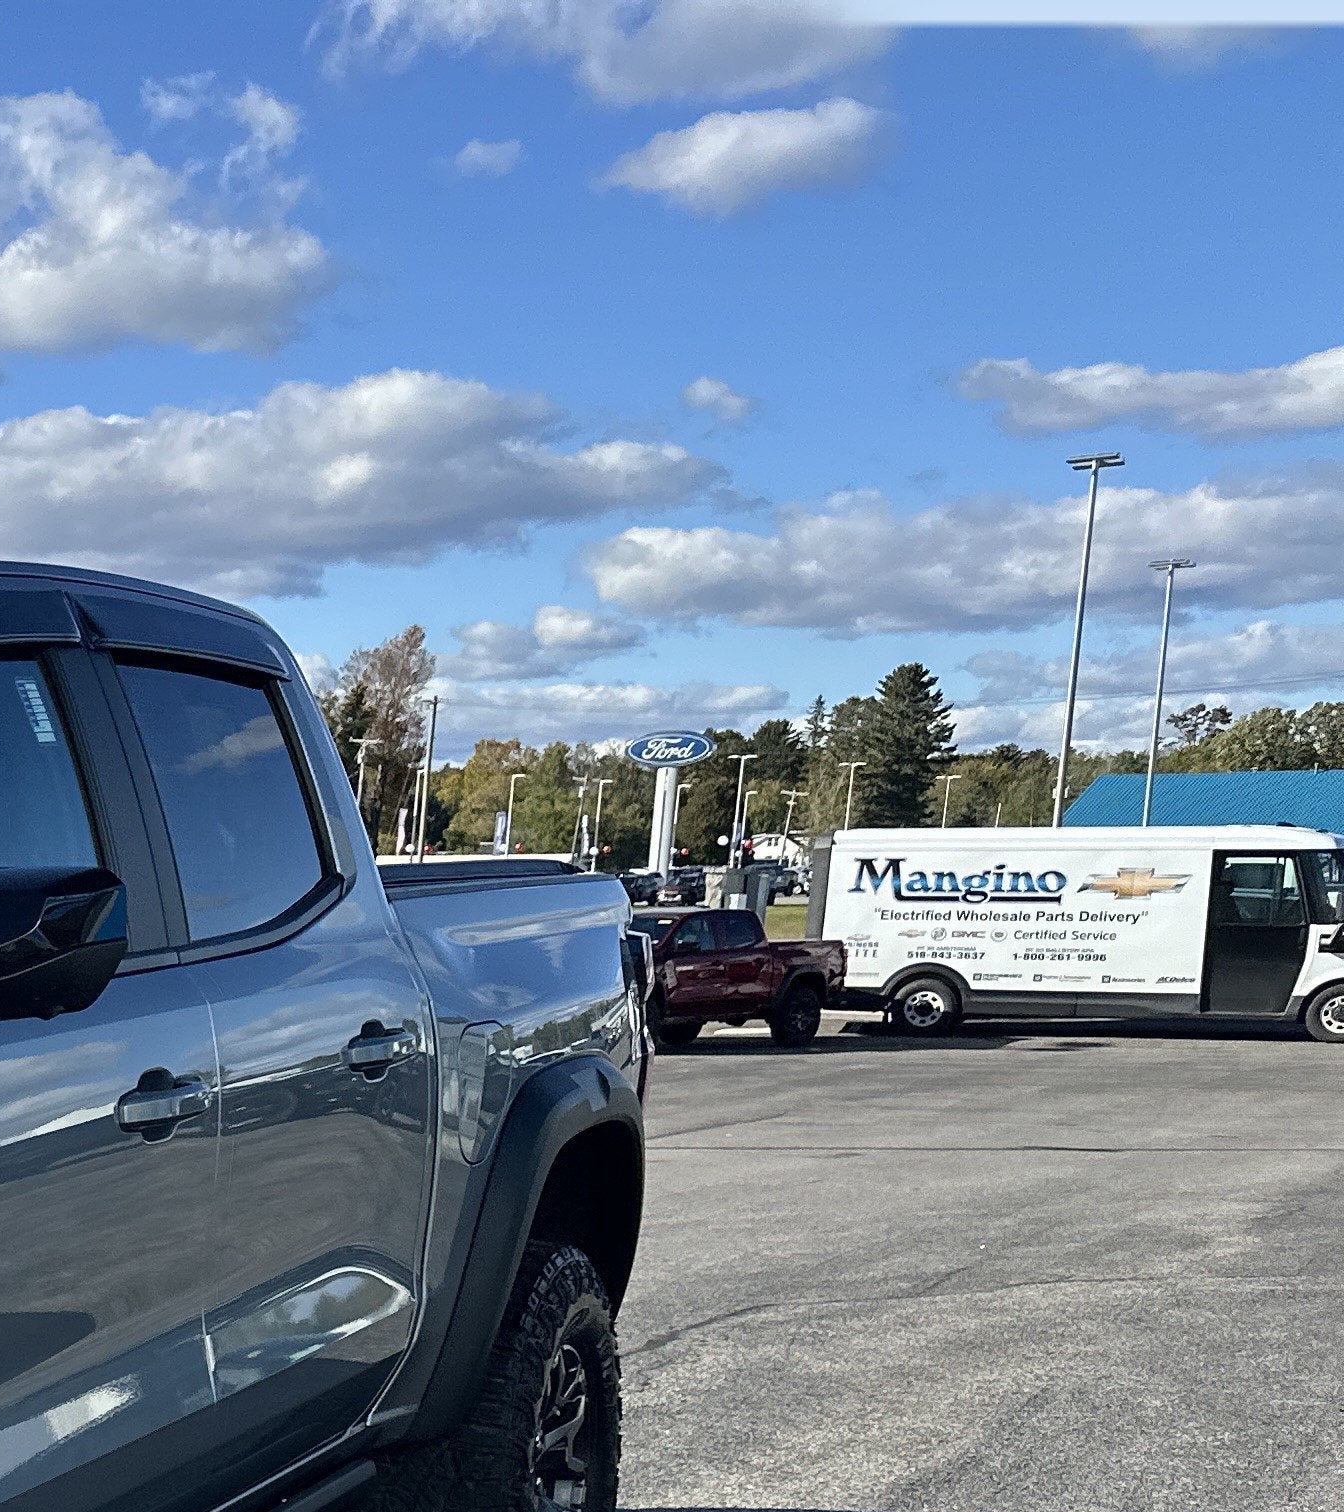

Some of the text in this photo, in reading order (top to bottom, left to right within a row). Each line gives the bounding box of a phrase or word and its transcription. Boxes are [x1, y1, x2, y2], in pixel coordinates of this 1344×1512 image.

[642, 737, 696, 760] Ford
[847, 857, 1068, 904] Mangino
[956, 910, 1031, 923] Wholesale
[1035, 911, 1074, 923] Parts
[1013, 929, 1118, 942] Certified Service
